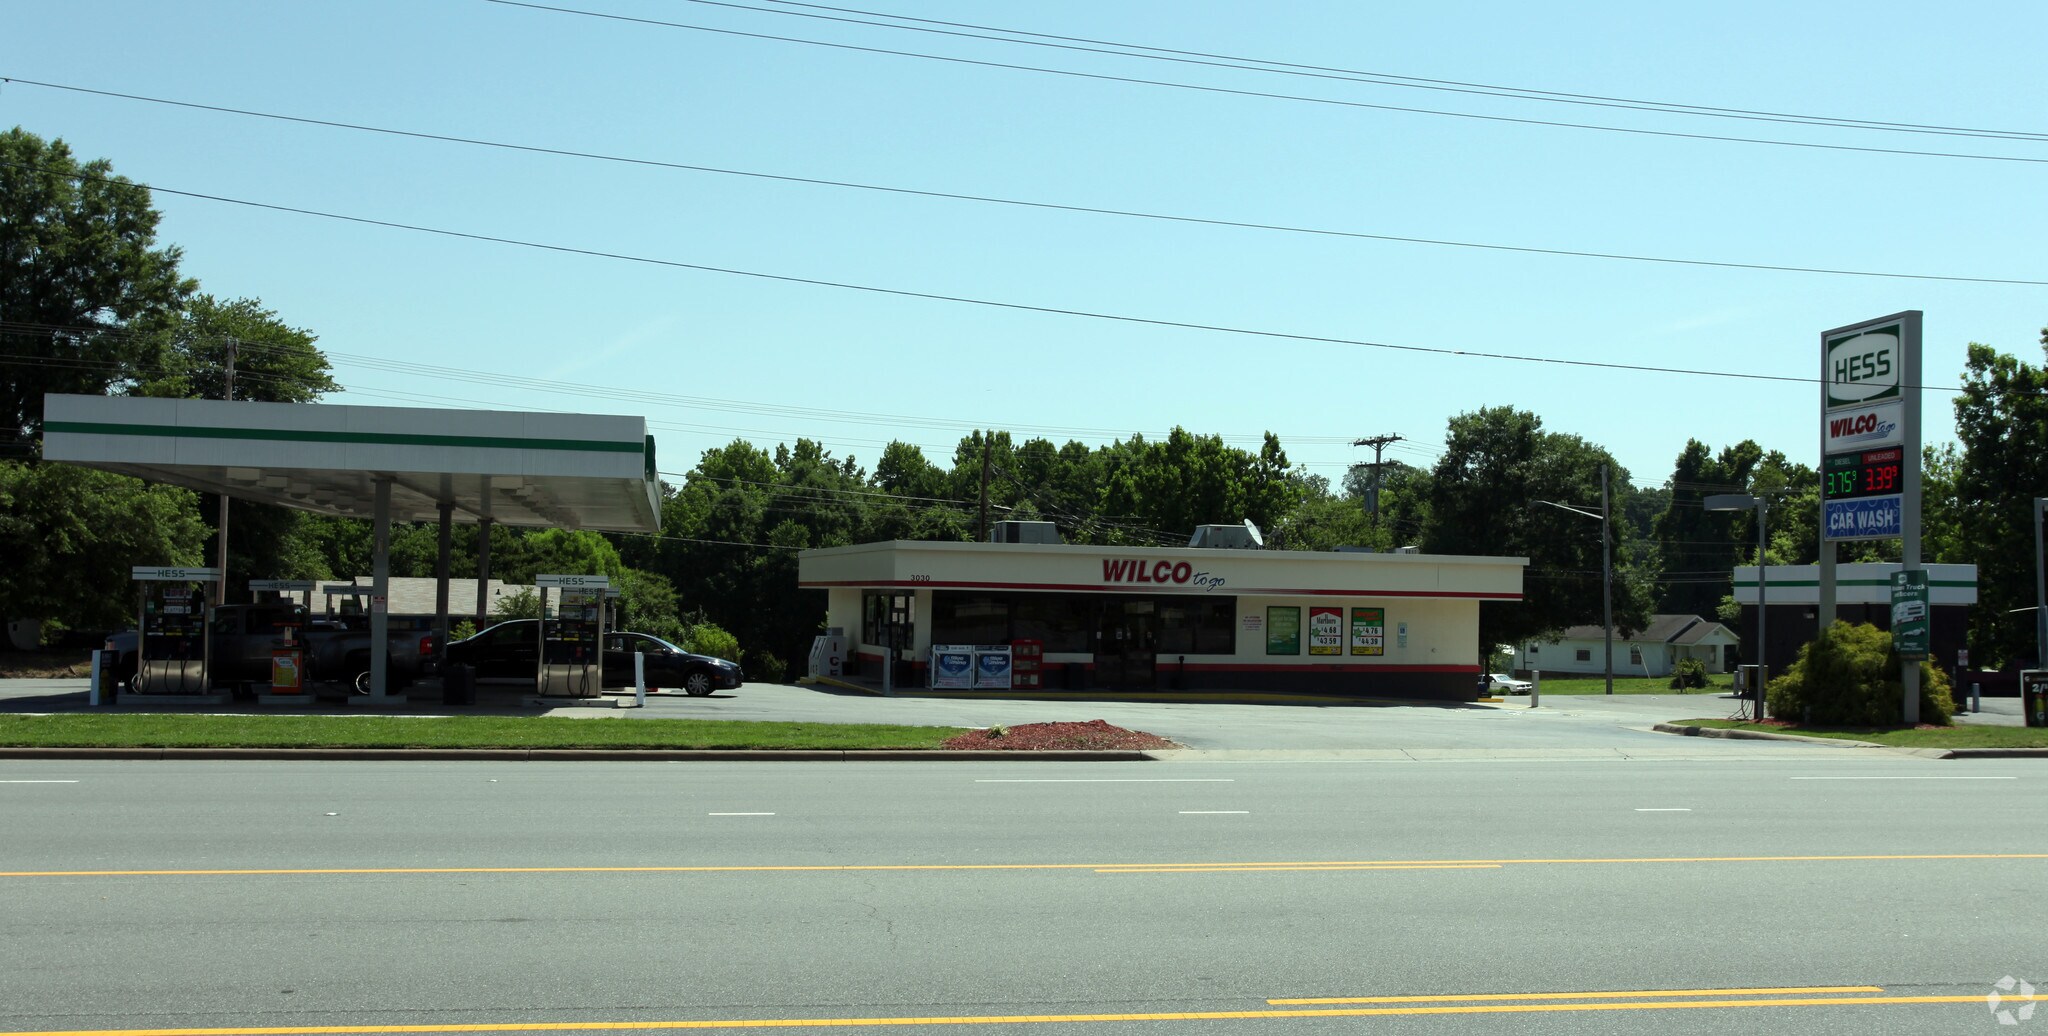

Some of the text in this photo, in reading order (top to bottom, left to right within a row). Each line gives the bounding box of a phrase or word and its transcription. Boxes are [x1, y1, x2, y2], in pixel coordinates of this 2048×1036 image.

[1835, 349, 1891, 385] HESS
[1830, 413, 1877, 438] WILCO
[1867, 452, 1896, 461] UNLEADED
[1830, 509, 1894, 530] CAR WASH
[157, 569, 185, 578] HESS
[558, 577, 584, 585] HESS
[1102, 559, 1193, 584] WILCO
